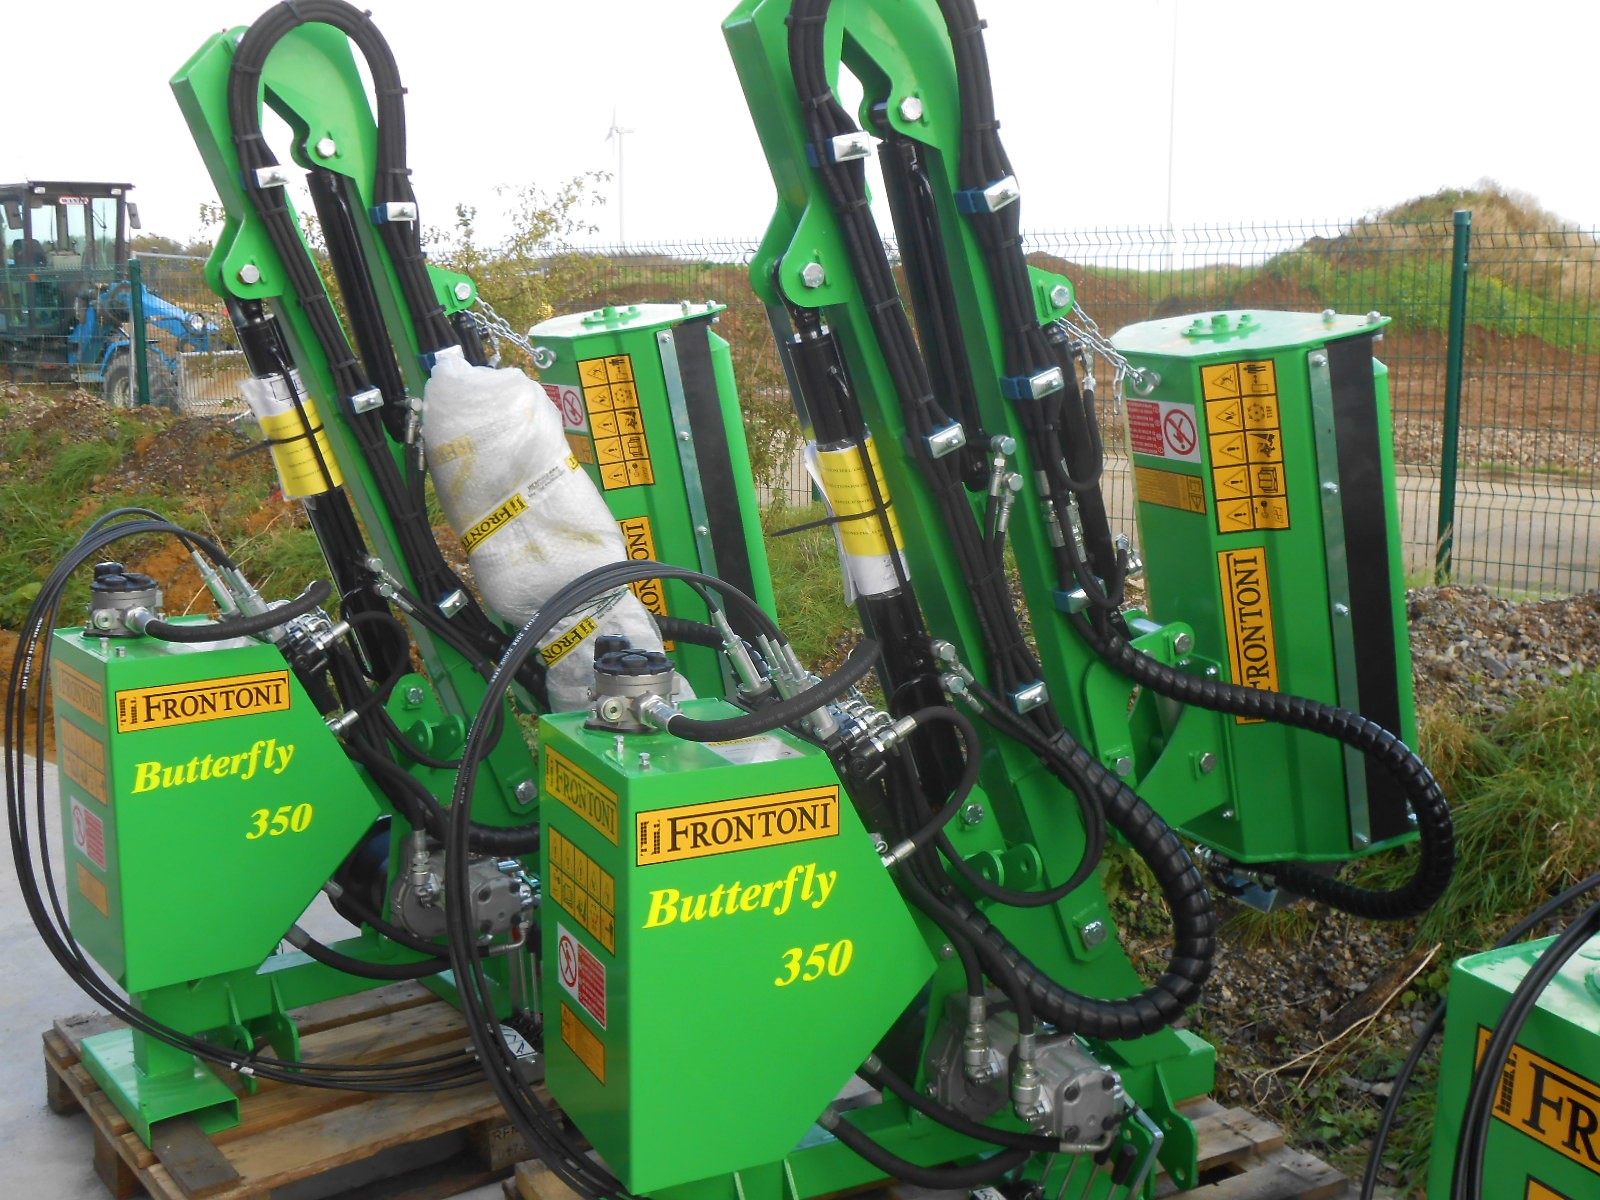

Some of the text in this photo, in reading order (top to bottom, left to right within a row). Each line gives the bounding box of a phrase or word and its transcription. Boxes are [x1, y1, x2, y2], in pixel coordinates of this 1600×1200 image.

[143, 678, 287, 722] FRONTONI
[131, 739, 294, 794] Butterfly
[246, 803, 313, 840] 350
[555, 760, 616, 835] FRONTONI
[667, 795, 836, 852] FRONTONI
[641, 863, 837, 928] Butterfly
[774, 939, 853, 986] 350
